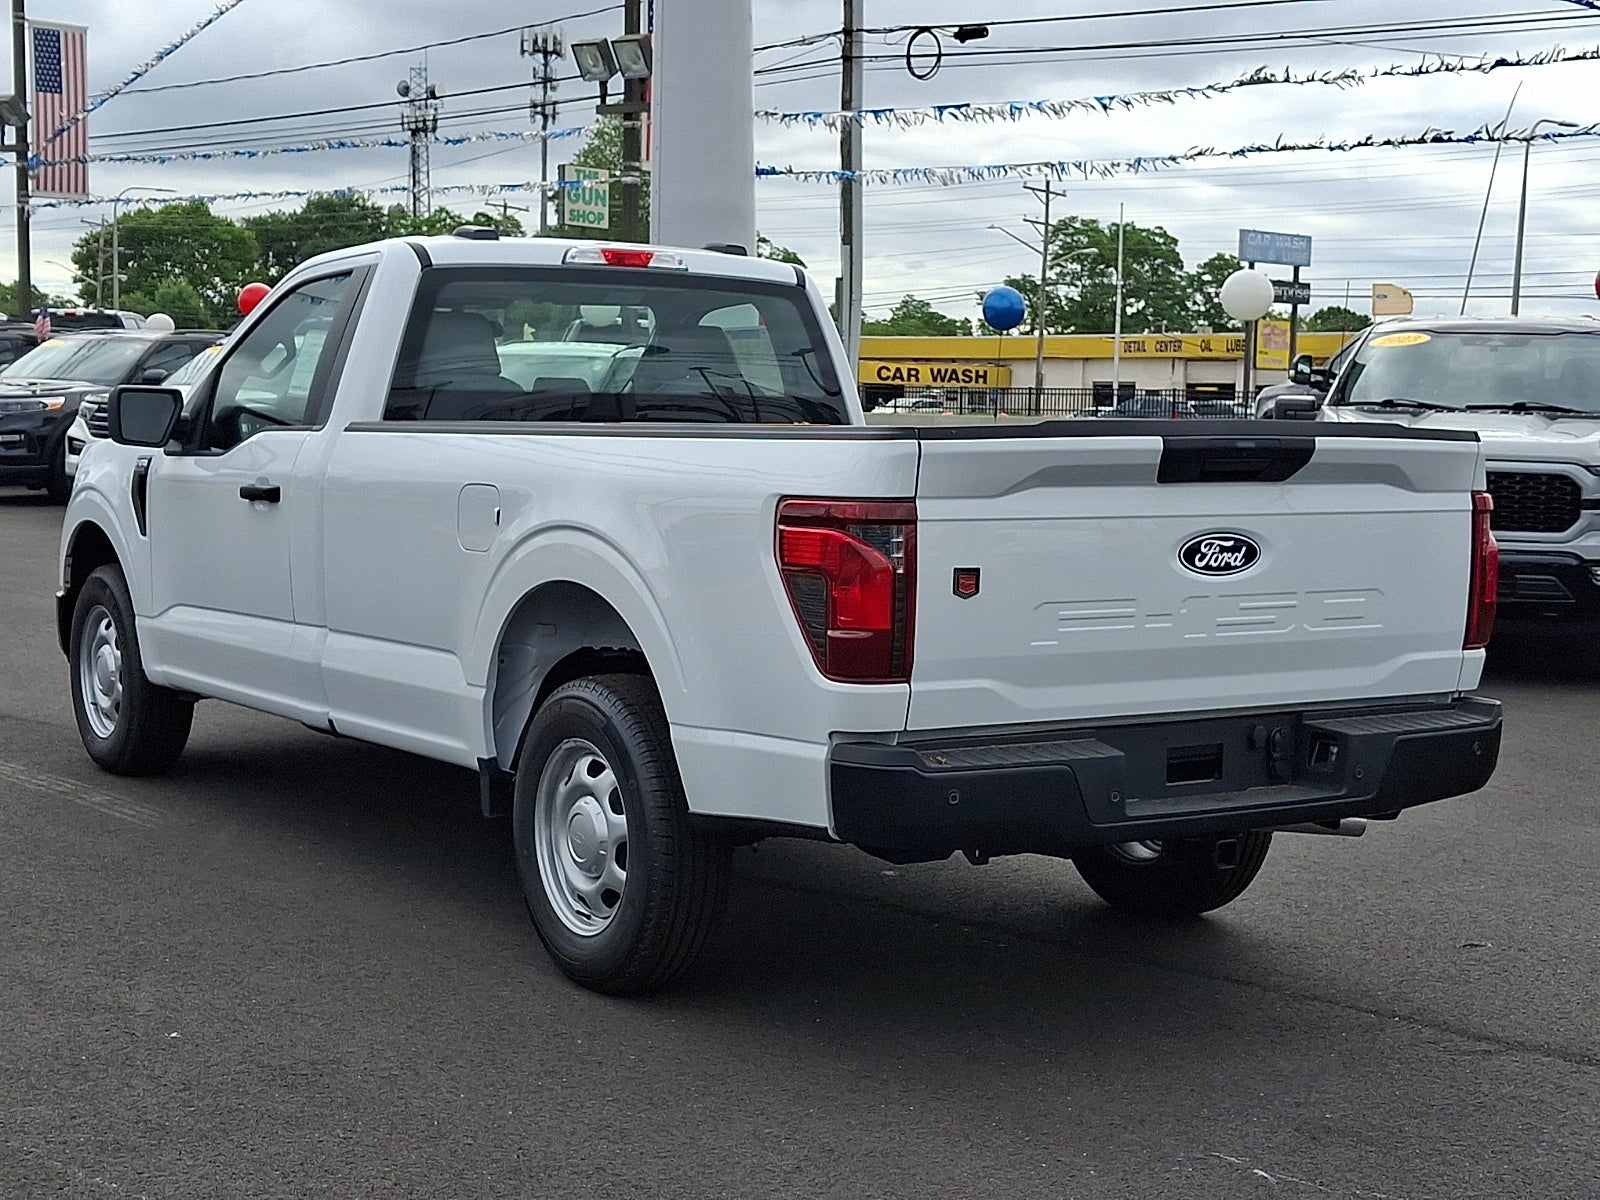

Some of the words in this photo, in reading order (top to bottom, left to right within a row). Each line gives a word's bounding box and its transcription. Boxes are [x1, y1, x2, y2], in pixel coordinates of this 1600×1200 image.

[574, 168, 599, 180] THE
[567, 186, 607, 207] GUN
[568, 209, 605, 225] SHOP
[1247, 232, 1271, 246] CAR
[1275, 235, 1307, 249] WASH
[1123, 340, 1146, 353] DETAIL
[1154, 340, 1182, 353] CENTER
[1200, 339, 1212, 352] OIL
[1226, 339, 1245, 353] LUBE
[876, 365, 920, 383] CAR
[929, 367, 988, 385] WASH
[1194, 539, 1247, 568] Ford
